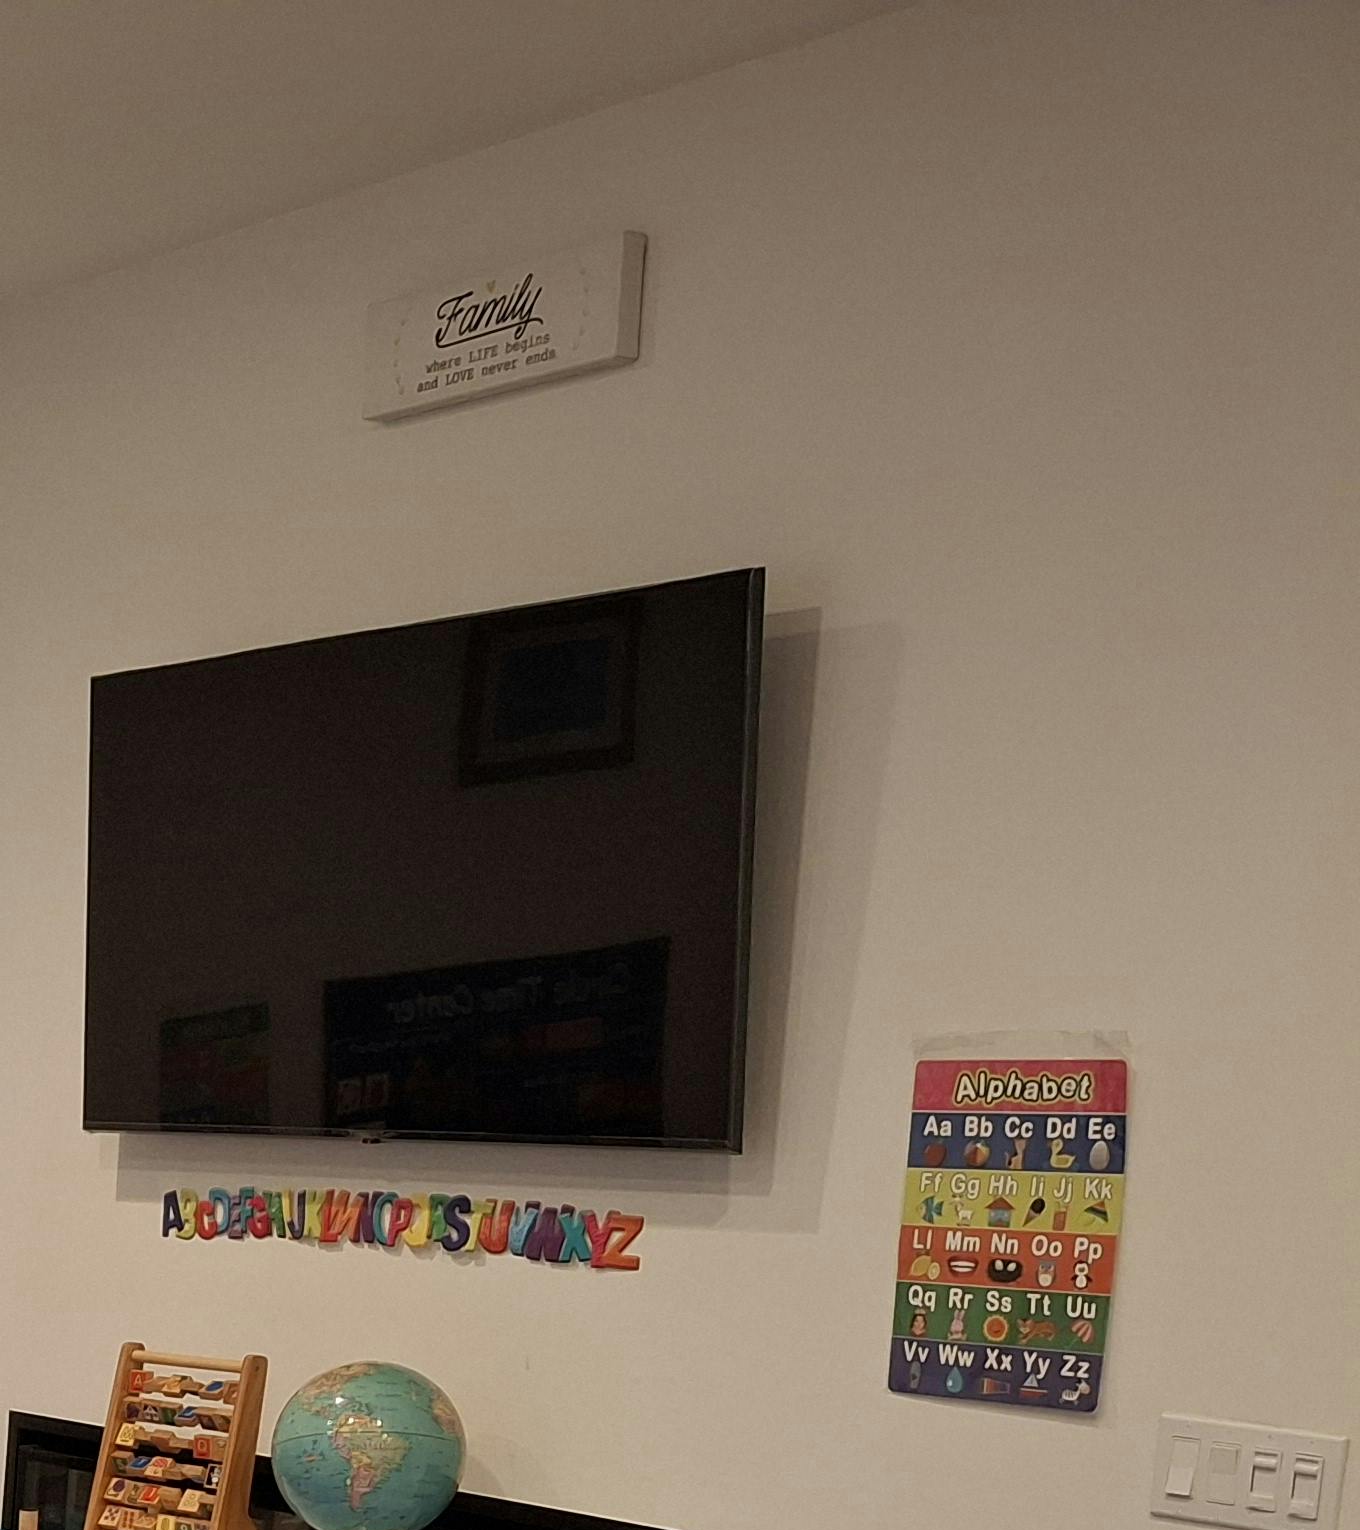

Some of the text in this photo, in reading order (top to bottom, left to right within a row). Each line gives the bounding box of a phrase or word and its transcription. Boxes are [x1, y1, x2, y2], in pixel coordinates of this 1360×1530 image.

[436, 273, 544, 348] Family
[417, 348, 556, 393] and LOVE never ends
[425, 333, 550, 374] where LIFE begins
[954, 1071, 1094, 1105] Alphabet
[923, 1115, 1117, 1140] Aa Bb Cc Dd Ee
[920, 1173, 1113, 1202] Ff Gg Hh Ii Jj Kk
[912, 1228, 1103, 1264] Ll Mm Nn Oo Pp
[907, 1284, 1096, 1320] Qq Rr Ss Tt Uu
[903, 1340, 1091, 1380] Vv Ww Xx Yy Zz
